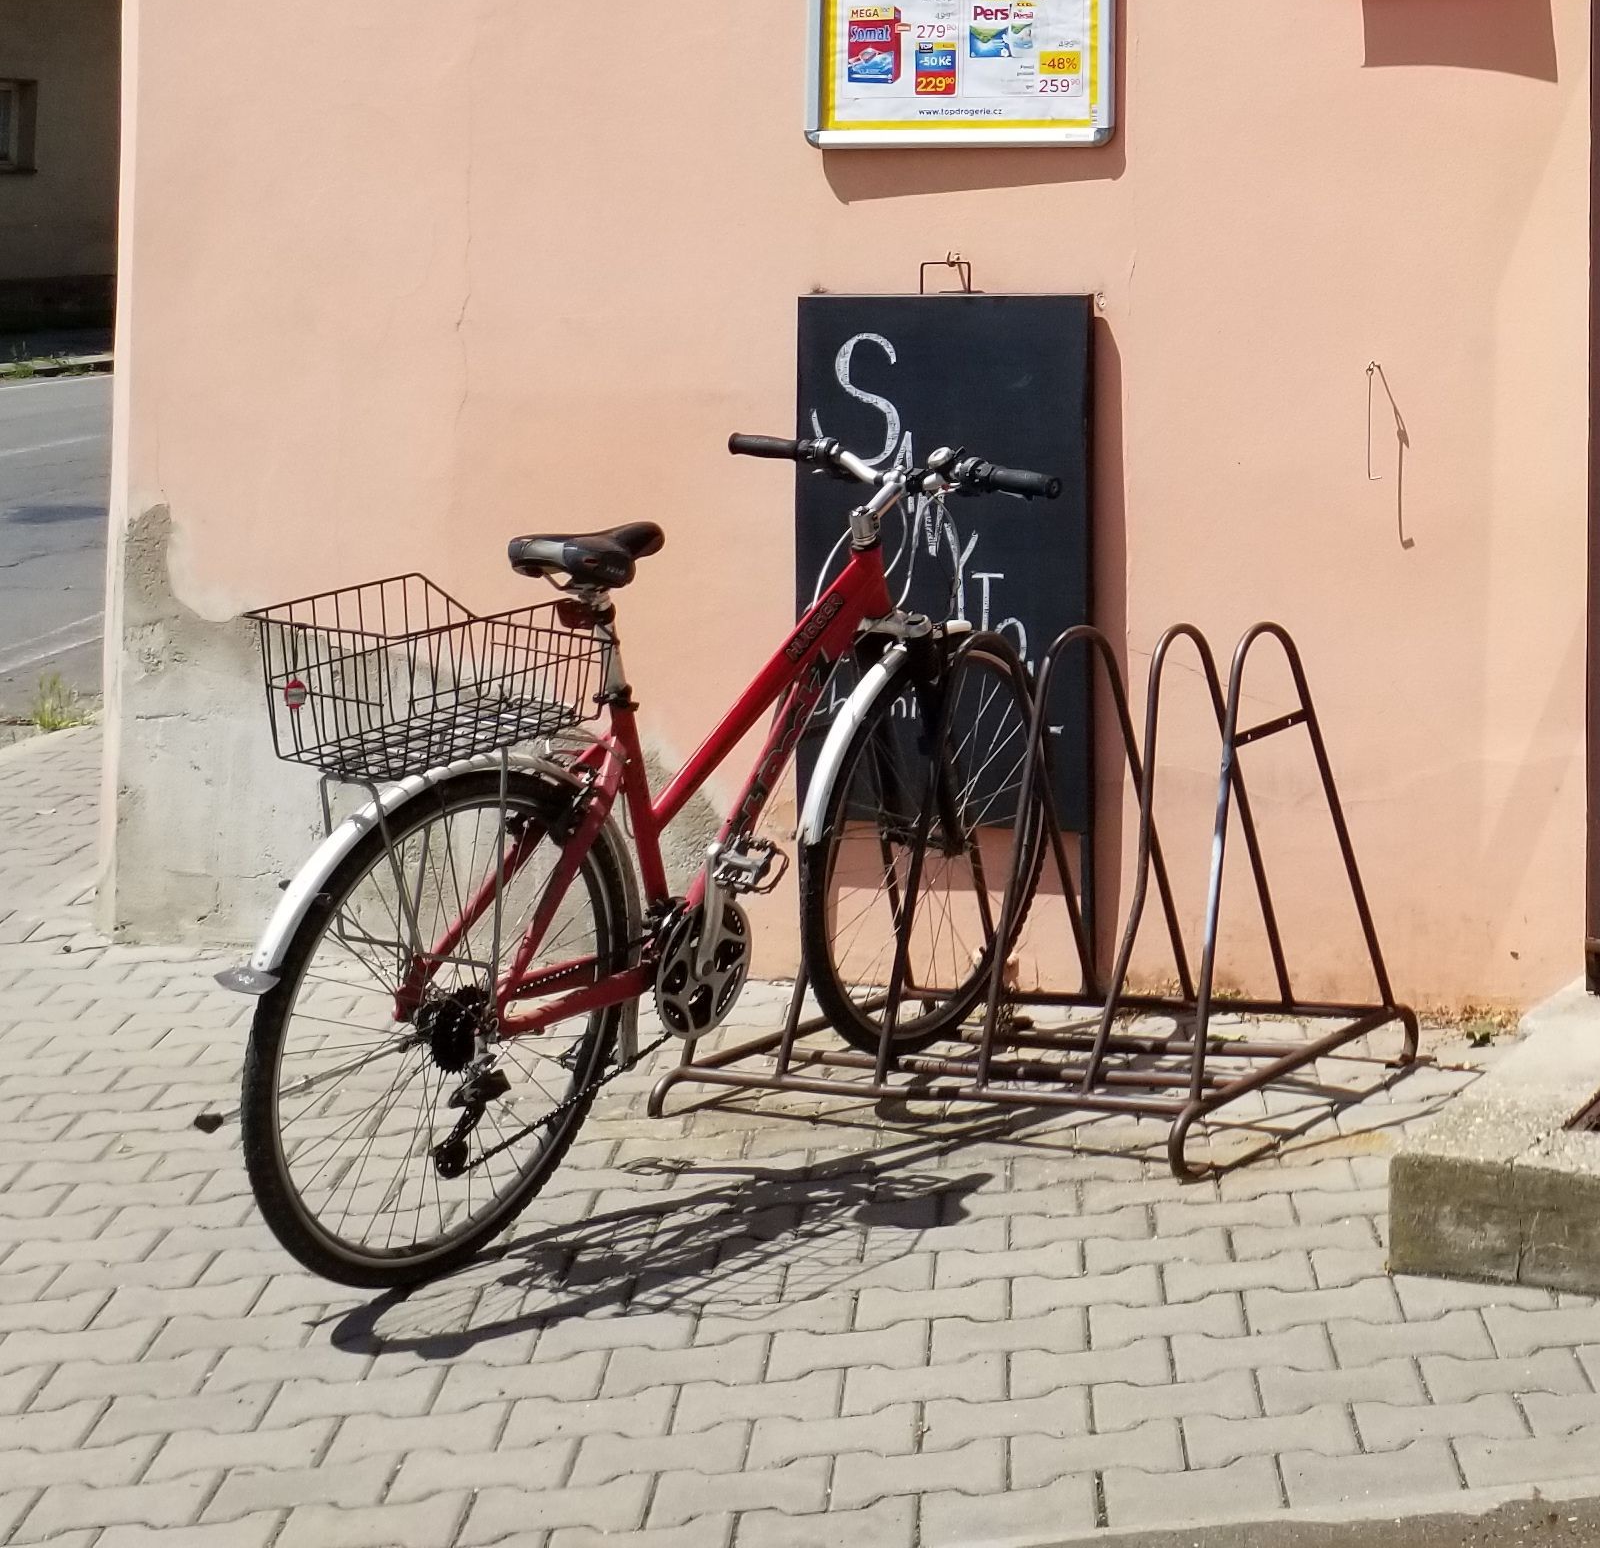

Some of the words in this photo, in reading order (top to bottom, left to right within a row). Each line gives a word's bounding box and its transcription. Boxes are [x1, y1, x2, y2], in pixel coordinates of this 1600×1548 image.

[851, 8, 880, 19] MEGA
[849, 24, 891, 43] Somat
[1041, 57, 1078, 70] -48%
[918, 107, 1003, 117] www.topdrogerie.cz
